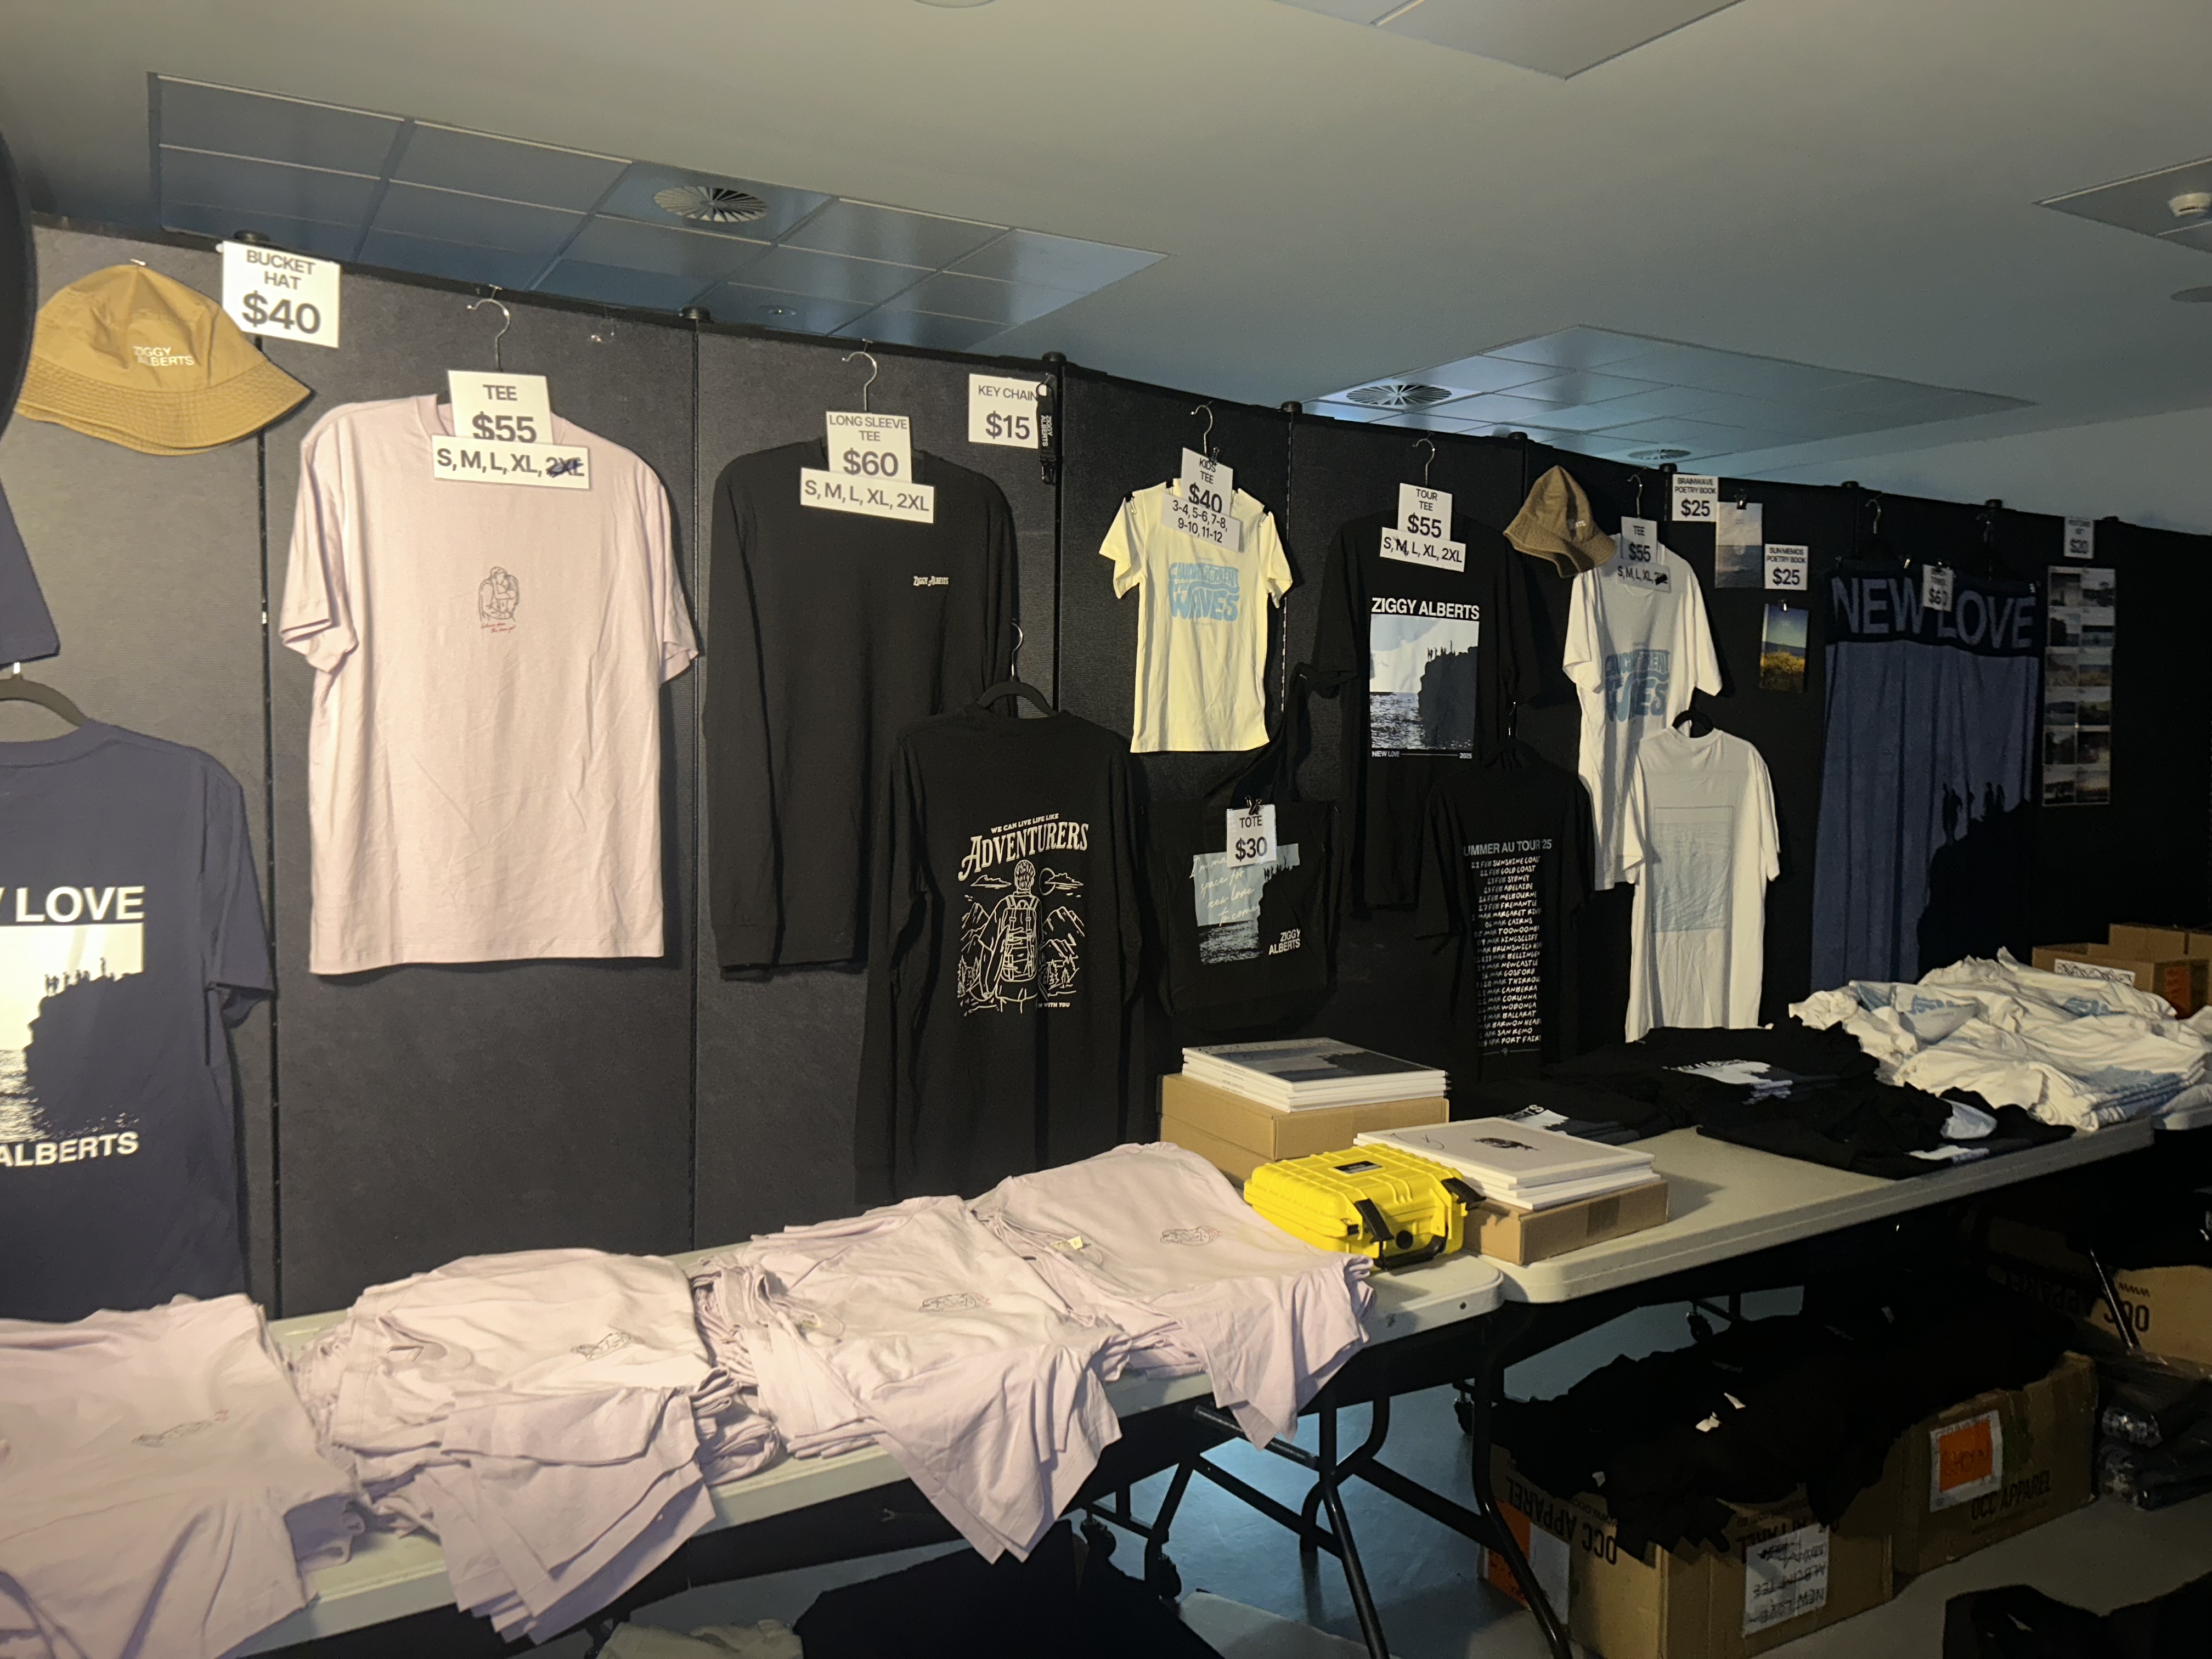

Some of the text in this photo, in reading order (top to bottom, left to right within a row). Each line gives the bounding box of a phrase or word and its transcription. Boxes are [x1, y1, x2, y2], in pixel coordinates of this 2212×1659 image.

[246, 250, 315, 275] BUCKET
[264, 271, 301, 290] HAT
[241, 290, 321, 334] $40
[482, 384, 518, 401] TEE
[978, 385, 1039, 402] KEY CHAIN
[471, 411, 537, 443] $55
[830, 414, 907, 430] LONG SLEEVE
[985, 410, 1030, 440] $15
[859, 430, 881, 442] TEE
[437, 448, 457, 471] S,
[460, 449, 487, 473] M,
[490, 452, 507, 475] L,
[510, 453, 543, 477] XL,
[843, 448, 899, 477] $60
[1199, 457, 1216, 472] KIDS
[1200, 471, 1214, 484] TEE
[804, 479, 929, 512] S, M, L, XL, 2XL
[1188, 482, 1222, 514] $40
[1416, 488, 1437, 501] TOUR
[1419, 500, 1433, 511] TEE
[1680, 497, 1711, 518] $25
[1178, 517, 1222, 544] 9-10, 11-12
[1407, 512, 1442, 538] $55
[1633, 525, 1645, 536] TEE
[1383, 537, 1393, 552] S,
[1412, 541, 1420, 557] L,
[1423, 543, 1439, 561] XL,
[1441, 548, 1462, 563] 2XL
[1628, 541, 1651, 562] $55
[913, 575, 928, 586] ZIGGY
[1772, 566, 1800, 586] $25
[1371, 597, 1480, 620] ZIGGY ALBERTS
[1831, 577, 2037, 649] NEW LOVE
[991, 813, 1059, 834] WE CAN LIVE LIFE LIKE
[1239, 815, 1262, 828] TOTE
[958, 821, 1089, 882] ADVENTURERS
[1234, 836, 1267, 862] $30
[1463, 839, 1541, 856] UMMER AU TOUR
[1492, 856, 1524, 867] SUNSHINE
[1500, 866, 1516, 875] GOLD
[1516, 864, 1536, 874] COAST
[1504, 882, 1533, 891] ADELAIDE
[1507, 874, 1530, 883] SYDNEY
[1499, 890, 1537, 900] MELBOURNE
[15, 885, 145, 923] LOVE
[1500, 899, 1537, 910] FREMANTLE
[1492, 909, 1526, 918] MARGARET
[1508, 917, 1533, 926] CAIRNS
[1280, 928, 1301, 943] ZIGGY
[1500, 933, 1538, 944] KINGSCLIFF
[1268, 938, 1301, 956] ALBERTS
[1500, 958, 1539, 969] NEWCASTLE
[1503, 968, 1536, 977] GOSFORD
[1501, 984, 1538, 994] CANBERRA
[1502, 993, 1538, 1002] CORUNNA
[1501, 1001, 1537, 1011] WODONGA
[1502, 1010, 1537, 1019] BALLARAT
[1491, 1019, 1523, 1028] BARWON
[1497, 1029, 1511, 1037] SAN
[1511, 1026, 1533, 1035] REMO
[1501, 1036, 1522, 1044] PORT
[0, 1131, 139, 1167] ALBERTS
[1505, 1476, 1578, 1542] APPAREL
